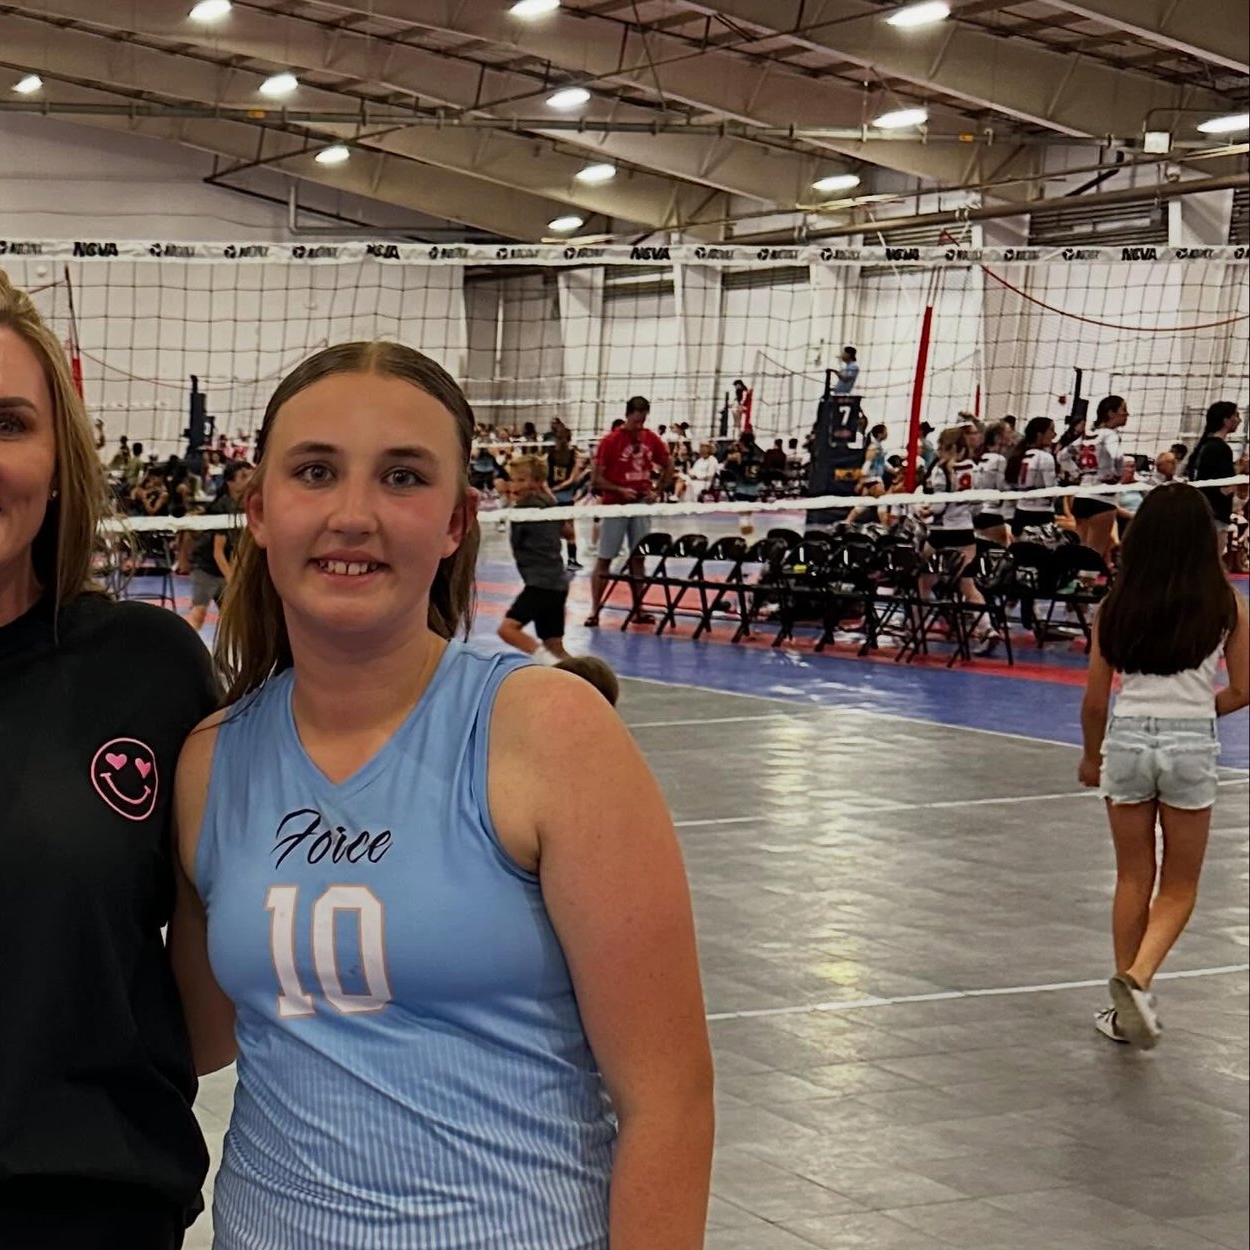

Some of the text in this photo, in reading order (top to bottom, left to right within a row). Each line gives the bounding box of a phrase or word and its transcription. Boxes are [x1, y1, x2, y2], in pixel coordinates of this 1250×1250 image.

[838, 405, 851, 426] 7
[269, 808, 393, 870] Force
[265, 884, 394, 1018] 10
